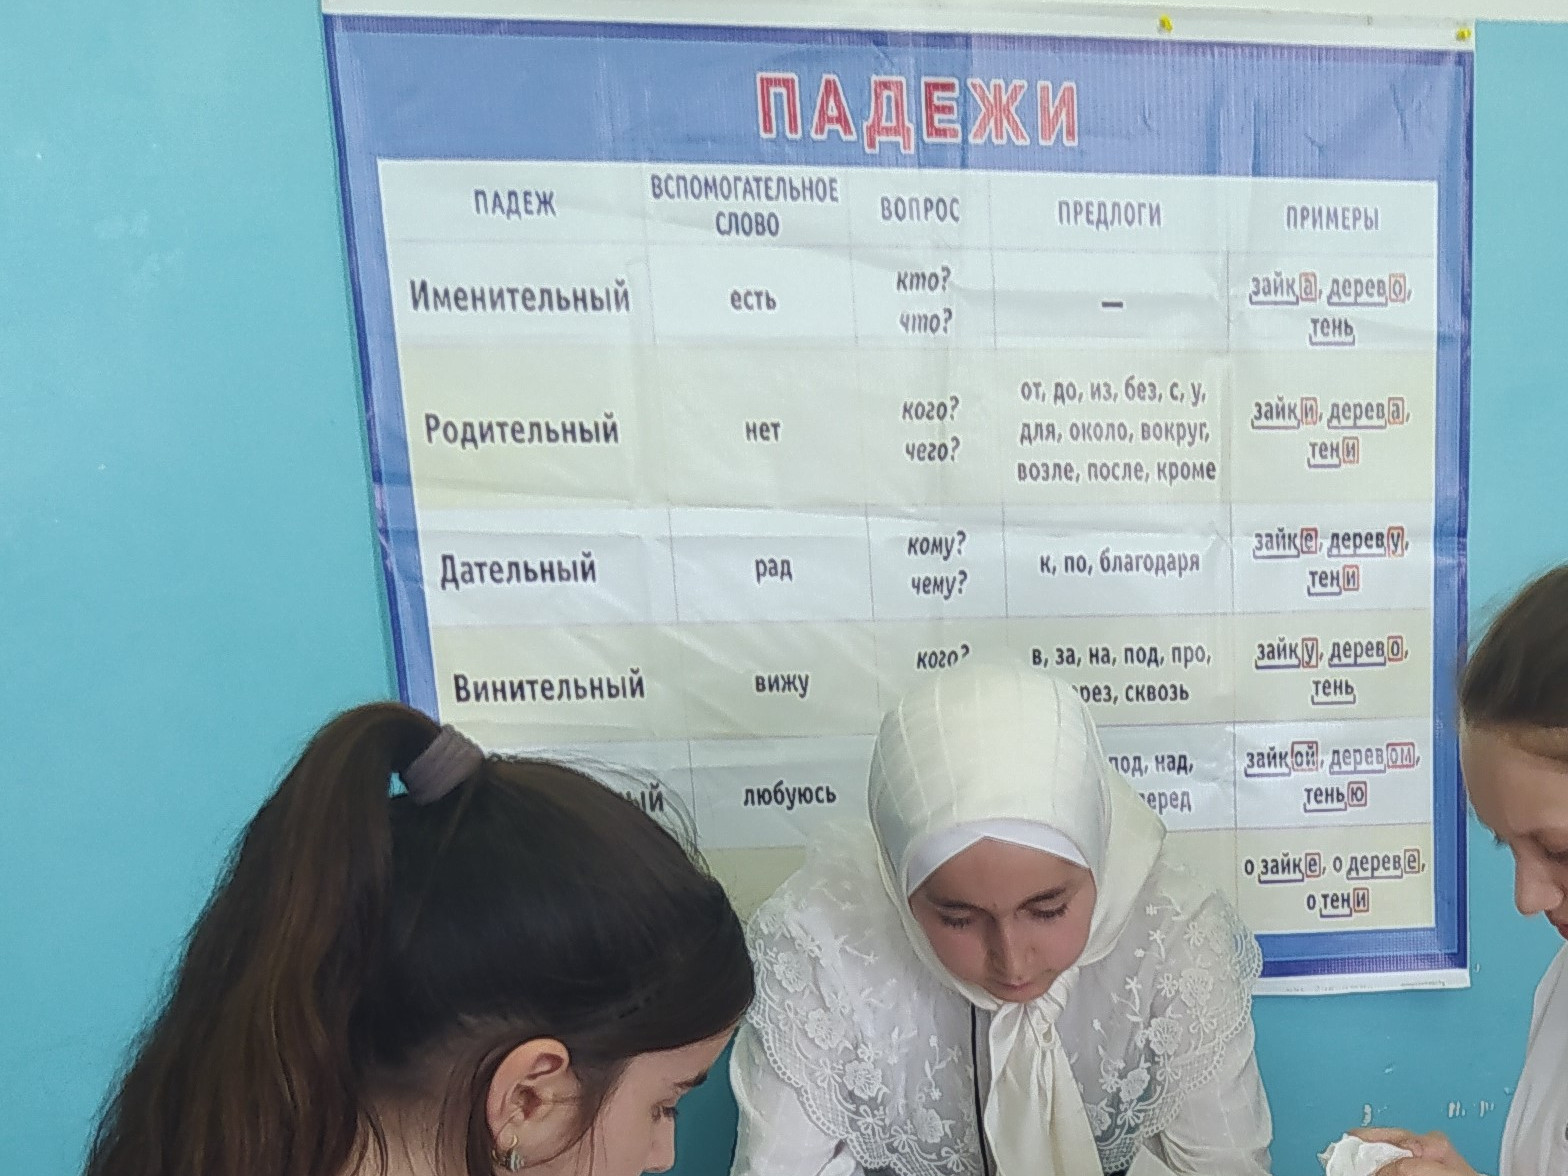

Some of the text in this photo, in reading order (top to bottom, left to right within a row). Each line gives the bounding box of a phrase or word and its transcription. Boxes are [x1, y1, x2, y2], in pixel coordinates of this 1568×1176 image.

[756, 72, 1079, 154] ПАДЕЖИ
[651, 174, 839, 203] ВСПОМОГАТЕЛЬНОЕ
[474, 190, 556, 219] ПАДЕЖ
[881, 197, 960, 223] ВОПРОС
[1058, 201, 1162, 231] ПРЕДЛОГИ
[716, 212, 780, 236] СЛОВО
[1286, 205, 1380, 231] ПРИМЕРЫ
[897, 265, 950, 292] кто?
[1250, 270, 1411, 304] зайка, дерево,
[410, 279, 630, 312] Именительный
[731, 288, 776, 311] есть
[900, 308, 952, 334] что?
[1310, 316, 1354, 338] тень
[1021, 376, 1206, 406] от, до, из, без, с, у,
[903, 395, 960, 421] кого?
[1253, 395, 1410, 424] зайки, дерева,
[424, 412, 619, 449] Родительный
[745, 421, 781, 443] нет
[1020, 422, 1210, 446] для, около, вокруг,
[906, 438, 960, 462] чего?
[1309, 435, 1360, 460] тени
[1017, 459, 1217, 484] возле, после, кроме
[908, 530, 967, 560] кому?
[1254, 526, 1409, 555] зайке, дереву,
[441, 552, 597, 590] Дательный
[755, 557, 793, 581] рад
[1040, 547, 1200, 577] к, по, благодаря
[912, 570, 968, 600] чему?
[1308, 564, 1358, 589] тени
[1032, 645, 1212, 668] в, за, на, под, про,
[1257, 636, 1408, 667] зайку, дерево,
[454, 668, 645, 702] Винительный
[755, 673, 809, 698] вижу
[1126, 684, 1189, 702] сквозь
[1312, 676, 1355, 698] тень
[1155, 753, 1193, 774] над,
[1246, 743, 1420, 771] зайкой, деревом,
[744, 780, 836, 810] любуюсь
[1139, 791, 1191, 815] еред
[1304, 784, 1366, 806] тенью
[1244, 852, 1425, 876] о зайке, о дереве,
[1306, 888, 1368, 910] о тени
